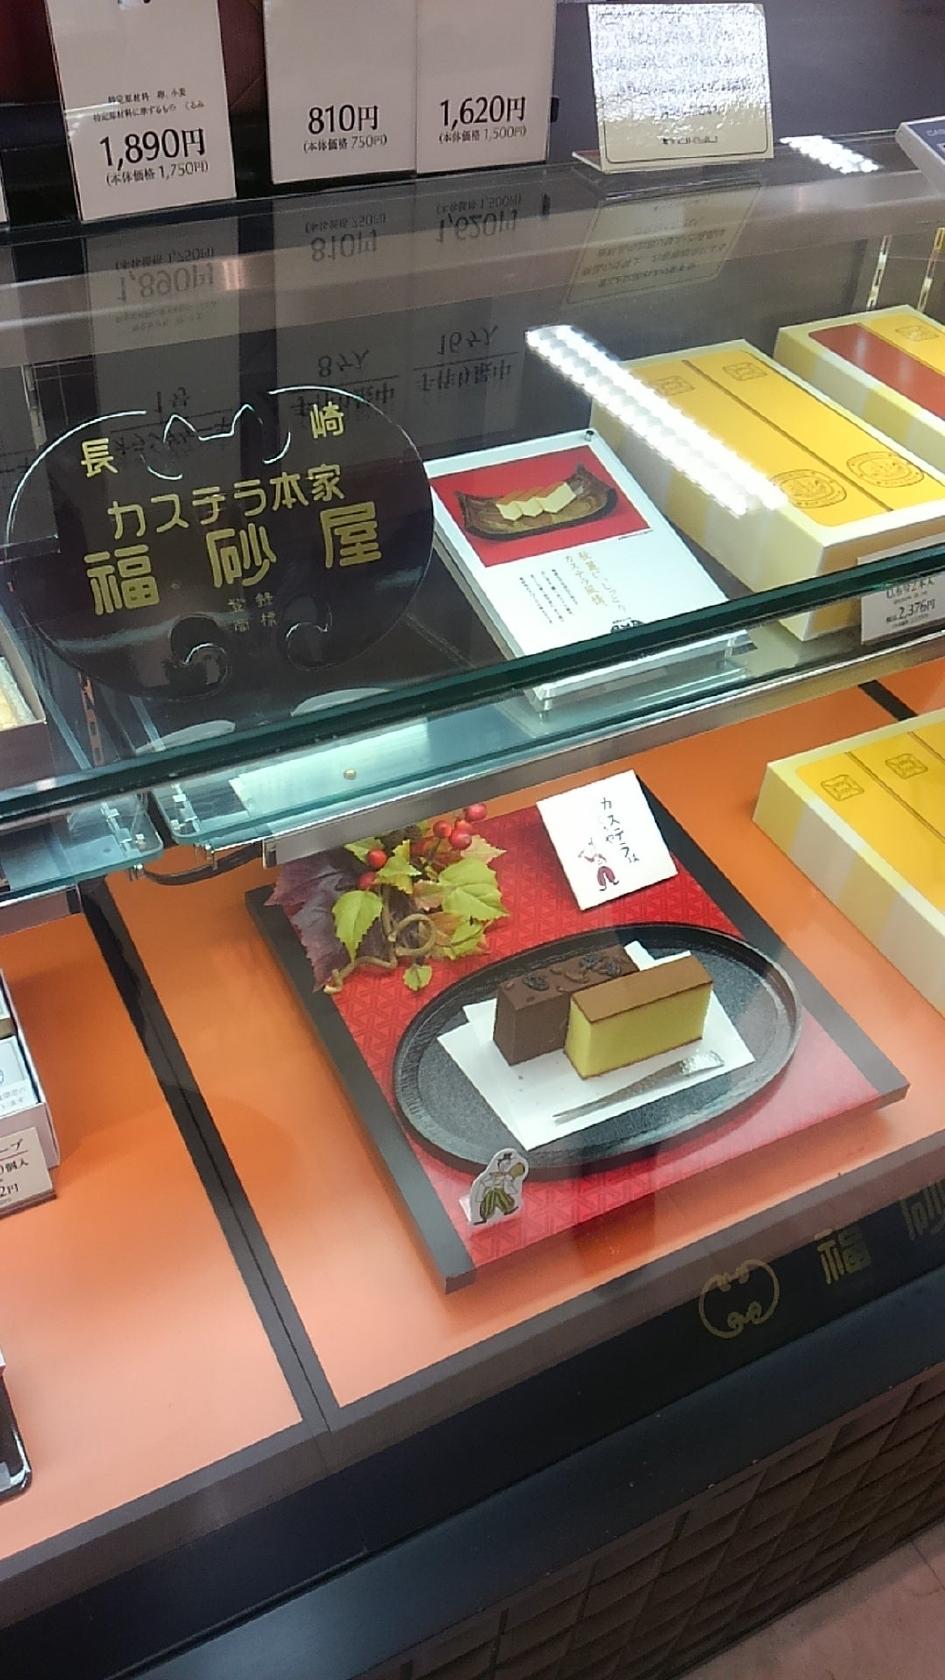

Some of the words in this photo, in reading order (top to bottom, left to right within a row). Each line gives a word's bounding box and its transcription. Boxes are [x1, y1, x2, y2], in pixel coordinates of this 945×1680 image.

[308, 104, 379, 134] 810円
[440, 95, 526, 129] 1,620円
[100, 128, 206, 171] 1,890円
[107, 463, 345, 540] カステラ本家
[84, 501, 382, 616] 福砂屋
